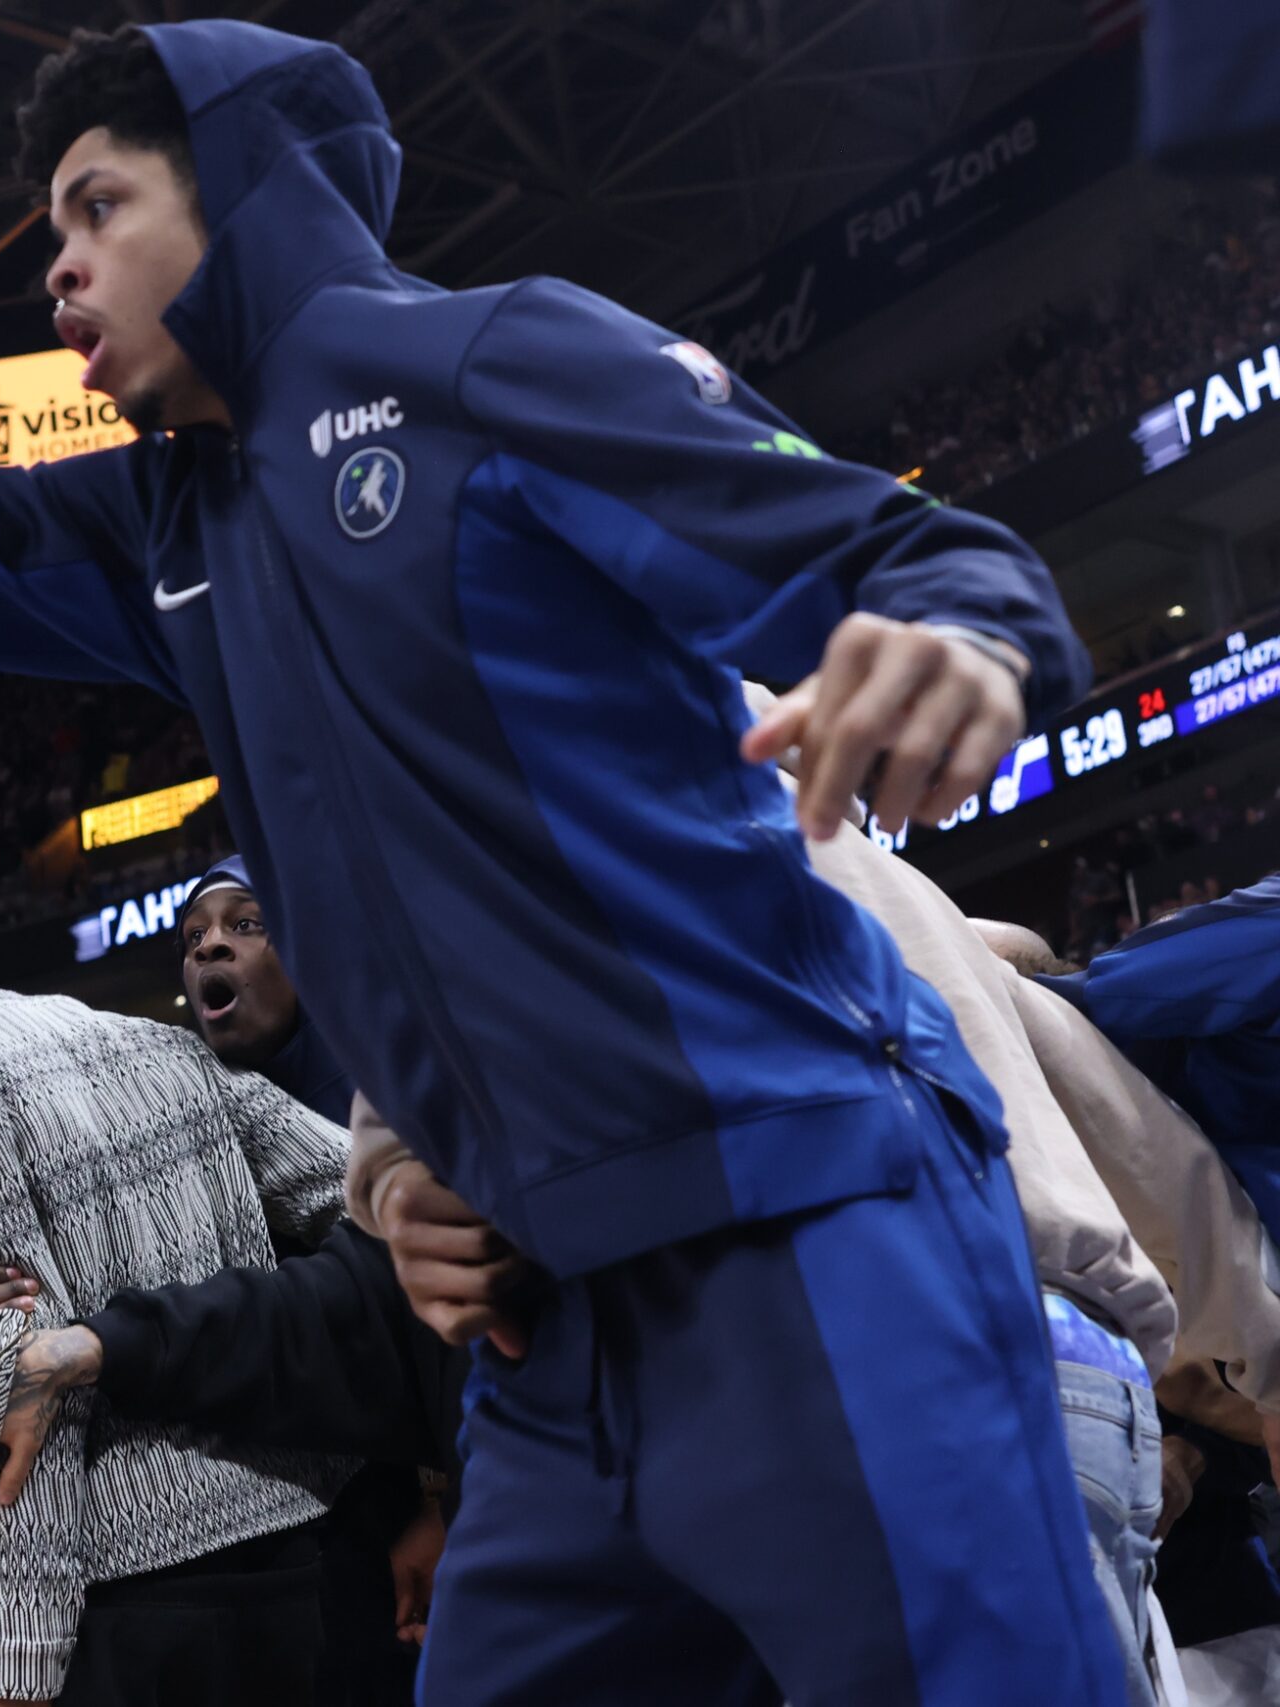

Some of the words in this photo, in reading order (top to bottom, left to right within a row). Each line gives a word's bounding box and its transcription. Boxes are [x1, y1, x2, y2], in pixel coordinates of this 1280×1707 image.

[845, 188, 922, 259] Fan
[929, 115, 1037, 207] Zone
[670, 264, 816, 373] Frd
[335, 396, 404, 441] UHC
[1138, 688, 1166, 719] 24
[1060, 708, 1127, 777] 5:29
